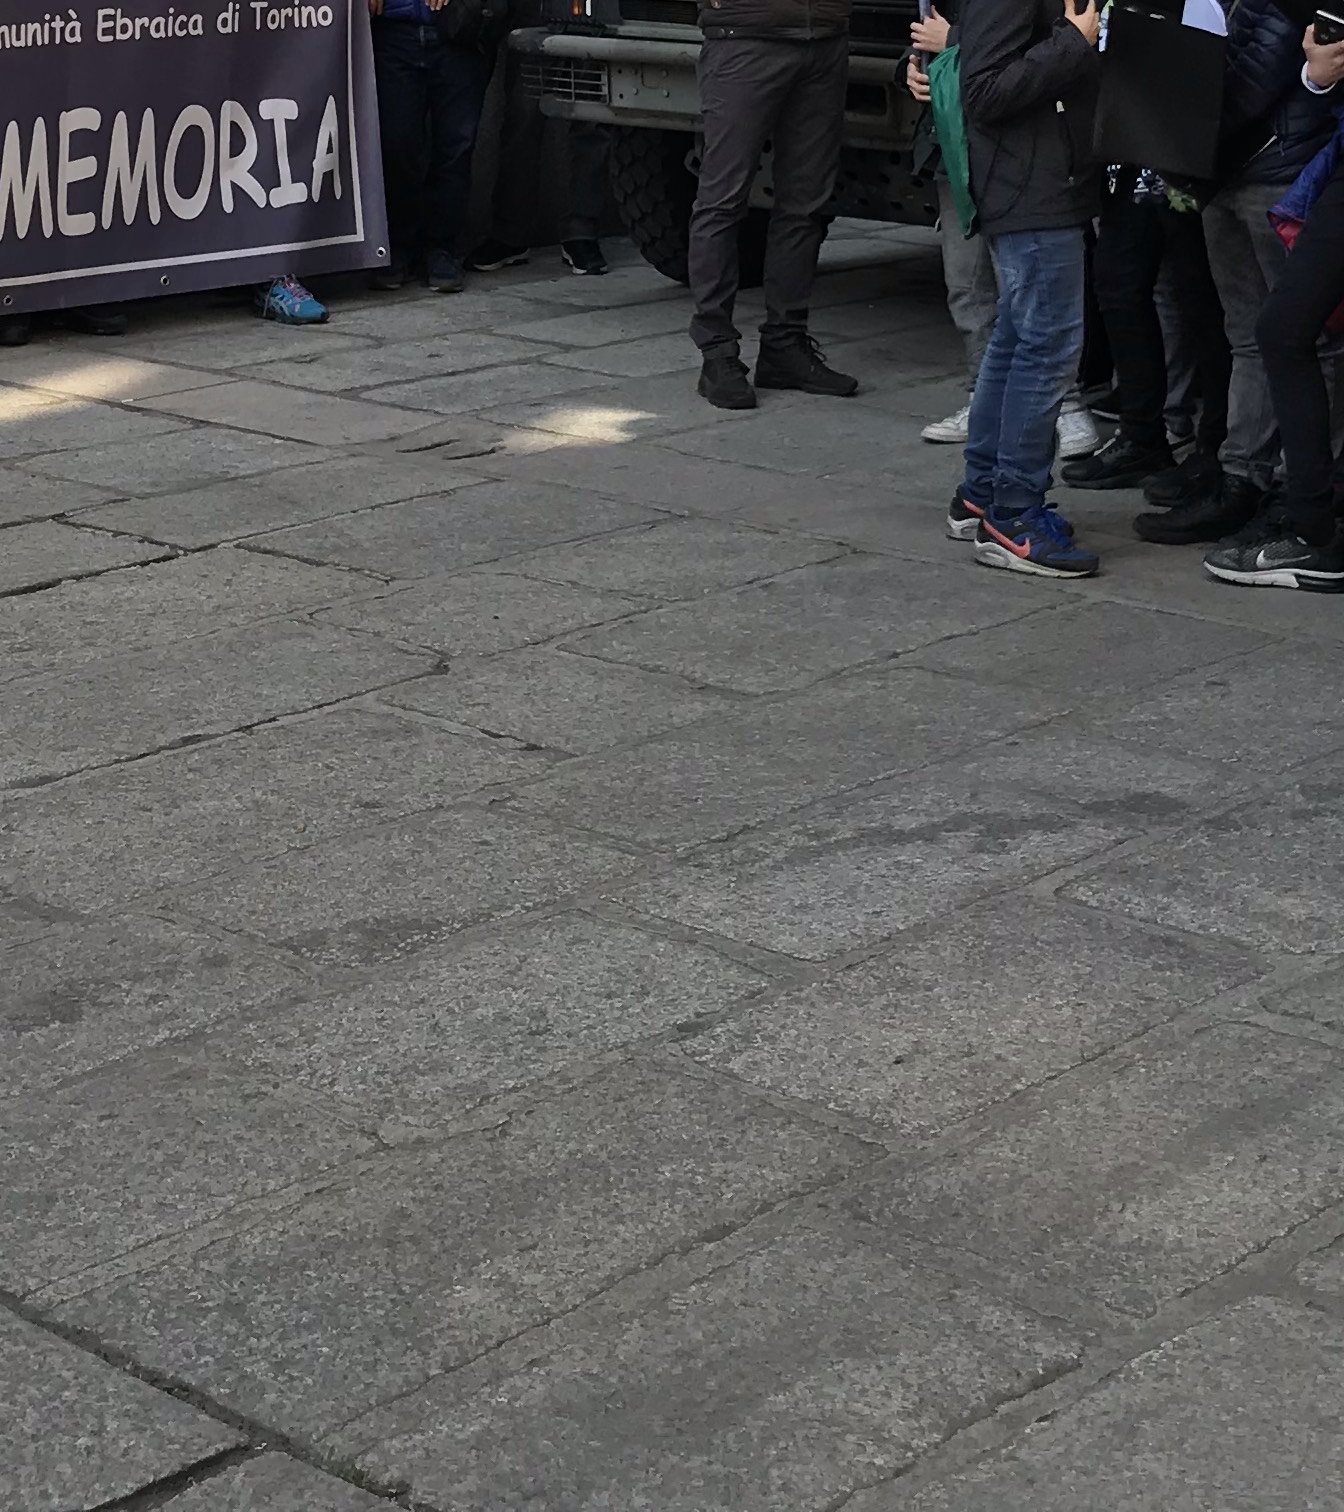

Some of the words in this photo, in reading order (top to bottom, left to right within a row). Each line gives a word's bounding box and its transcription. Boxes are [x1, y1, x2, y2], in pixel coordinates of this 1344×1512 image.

[96, 6, 204, 43] Ebraica
[216, 1, 241, 34] di
[250, 0, 334, 30] Torino
